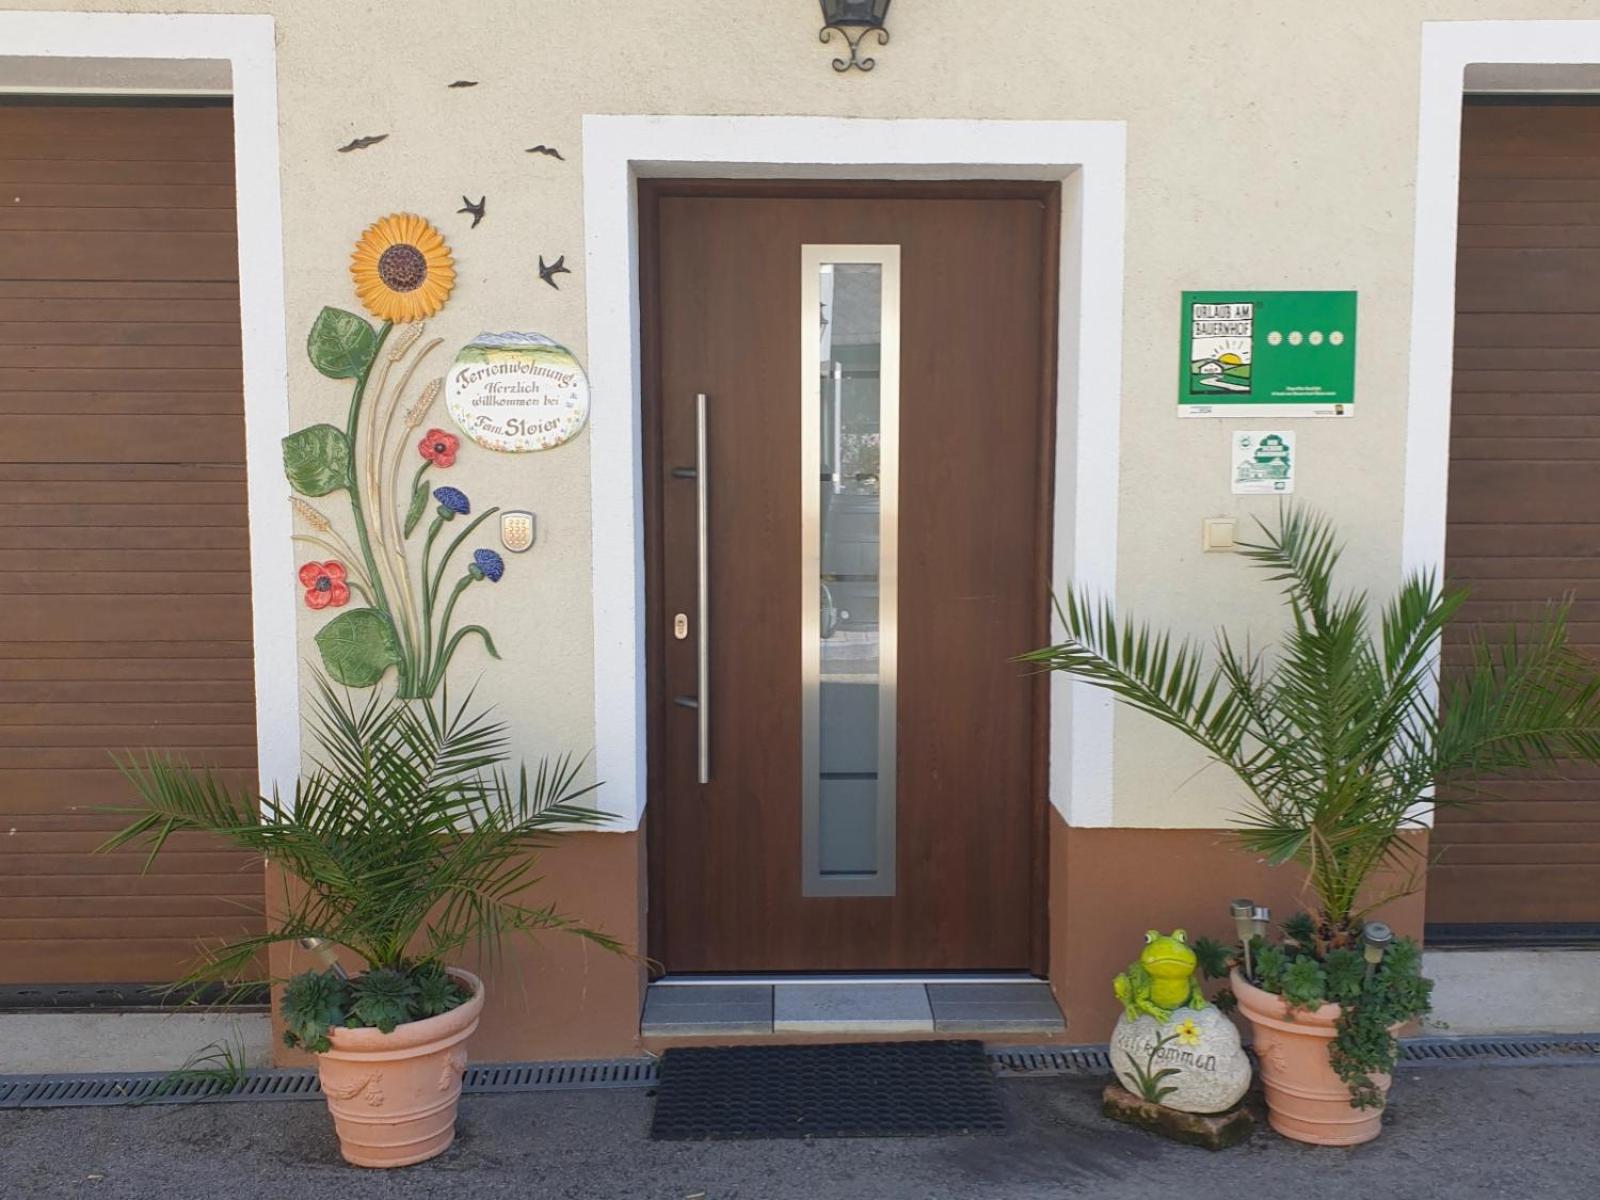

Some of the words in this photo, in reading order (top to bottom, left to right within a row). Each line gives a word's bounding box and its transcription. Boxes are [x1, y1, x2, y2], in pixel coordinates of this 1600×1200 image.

[1195, 305, 1231, 319] URLAUB
[1234, 305, 1250, 319] AM
[1195, 322, 1249, 336] BAUERNHOF
[456, 359, 575, 390] Ferienwohnung
[484, 381, 540, 394] Herzlich
[472, 395, 540, 406] willkommen
[543, 395, 559, 406] bei
